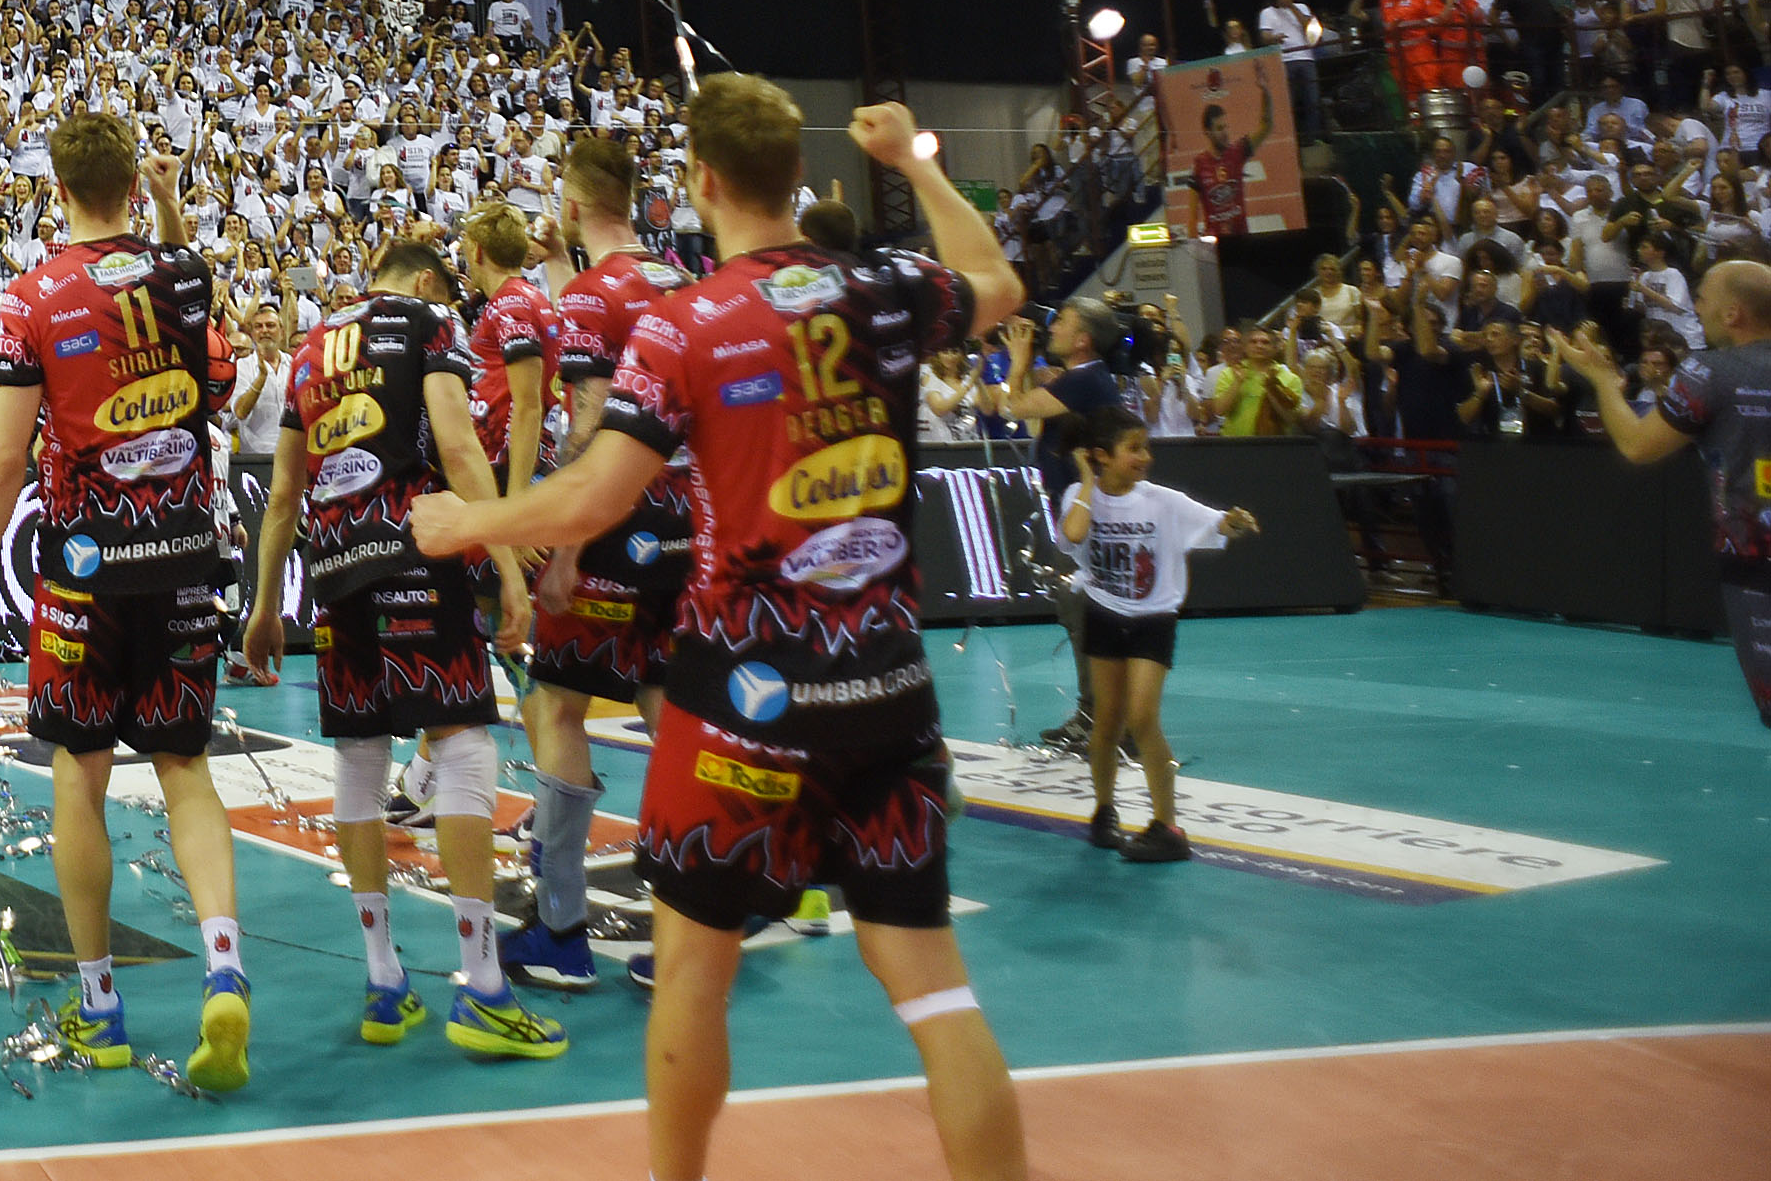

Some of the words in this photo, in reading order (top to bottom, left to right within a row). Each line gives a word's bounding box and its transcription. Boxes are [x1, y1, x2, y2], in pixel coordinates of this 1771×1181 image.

[113, 285, 160, 349] 11
[108, 344, 183, 378] SIIRILA
[323, 322, 363, 378] 10
[785, 313, 861, 402] 12
[104, 438, 195, 465] VALTIBERINO
[102, 531, 214, 562] UMBRAGROUP
[49, 607, 90, 632] SUSA
[1206, 802, 1564, 870] corriere
